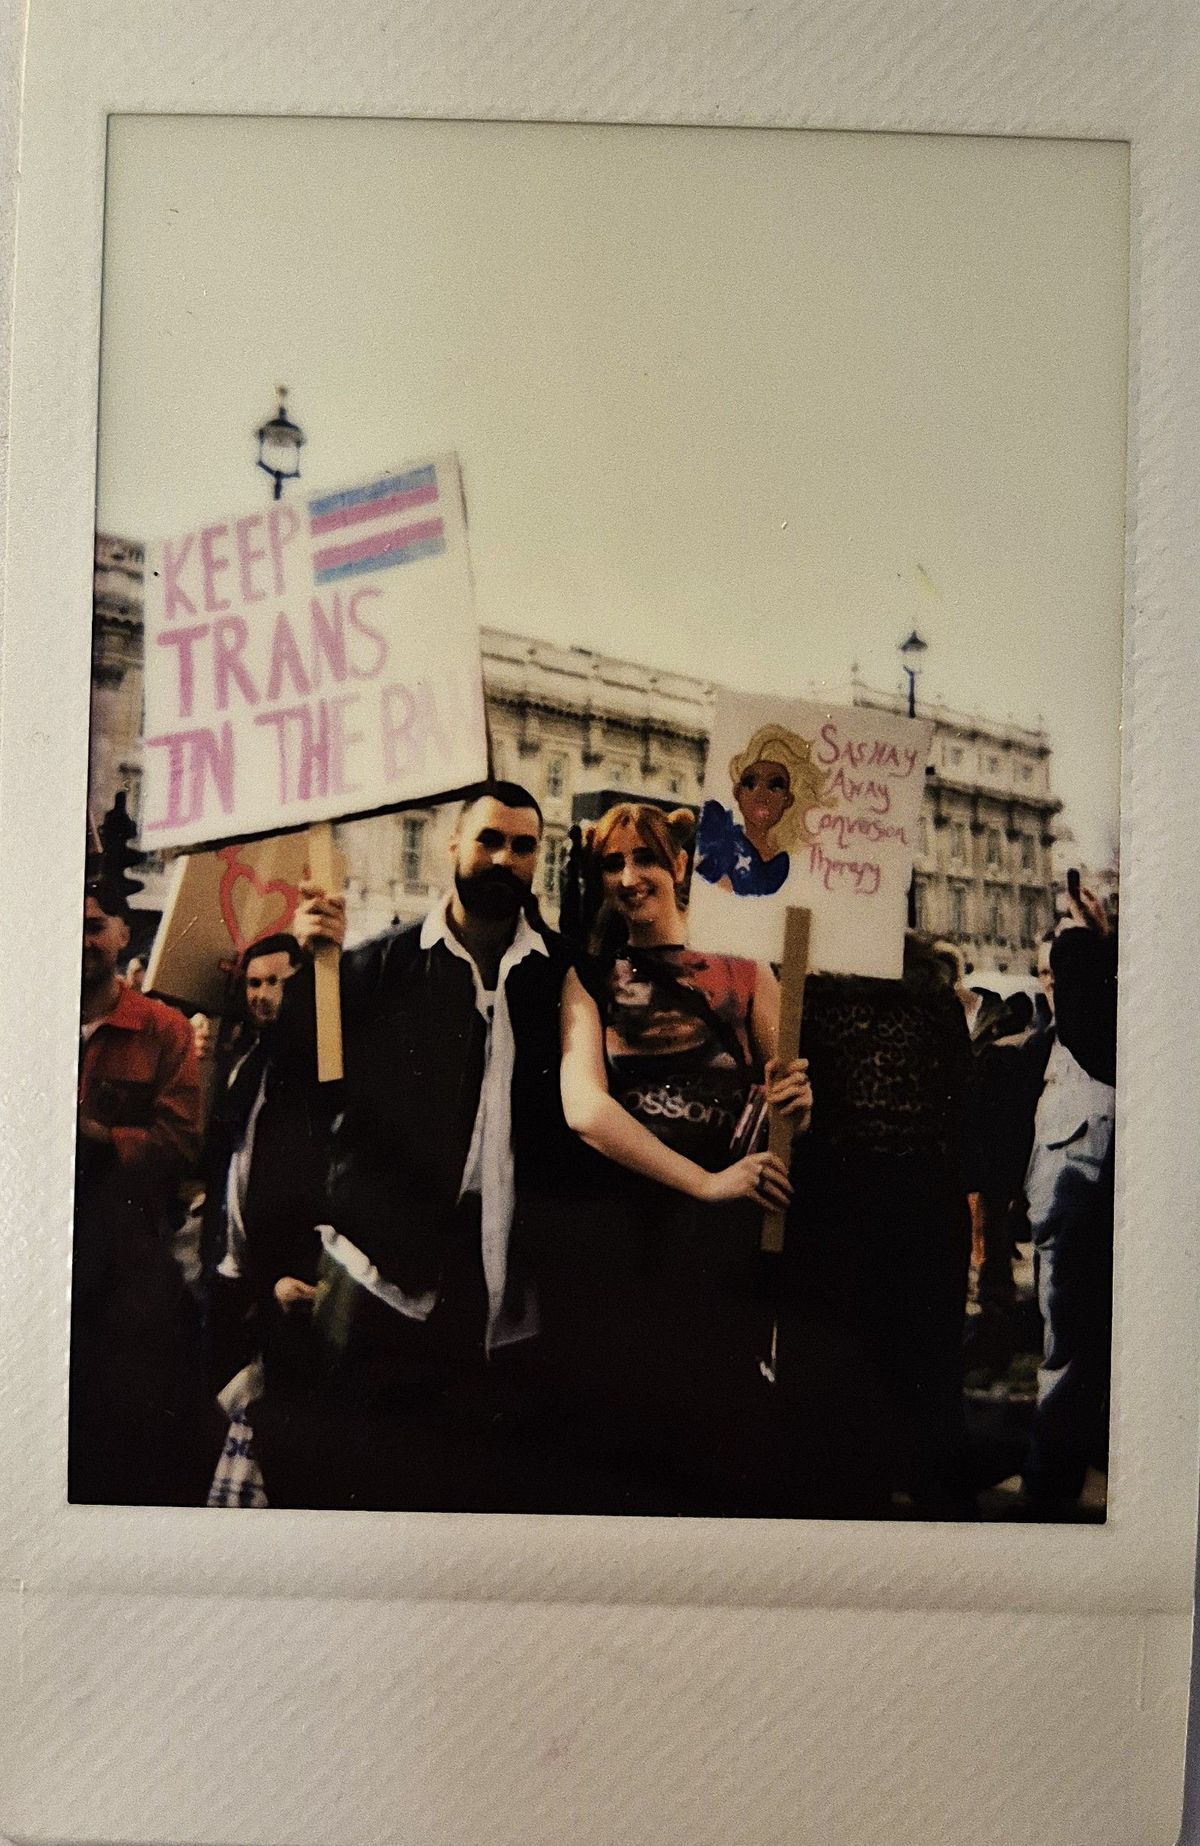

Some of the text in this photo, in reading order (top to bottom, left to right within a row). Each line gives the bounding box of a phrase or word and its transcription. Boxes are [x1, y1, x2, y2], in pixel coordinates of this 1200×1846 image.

[161, 504, 301, 621] KEEP
[156, 586, 390, 718] TRANS
[145, 719, 235, 831] IN
[254, 692, 365, 806] THE
